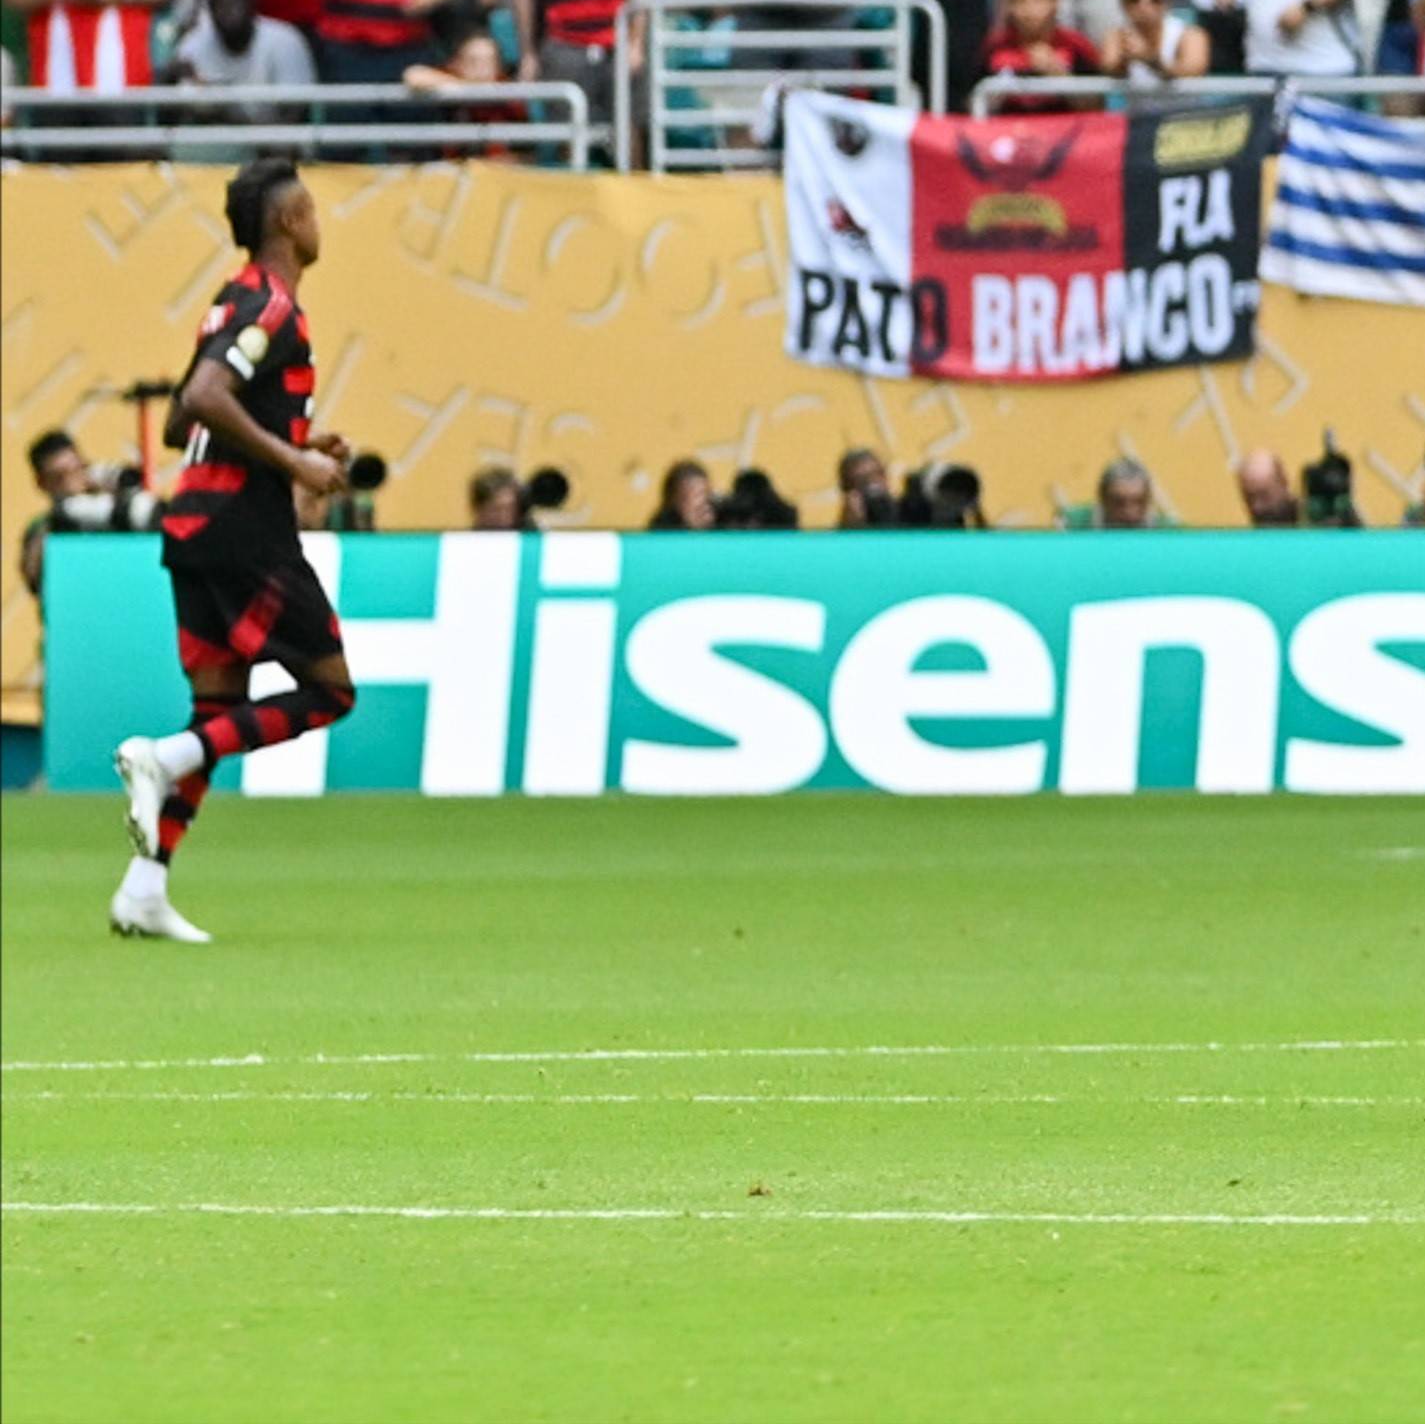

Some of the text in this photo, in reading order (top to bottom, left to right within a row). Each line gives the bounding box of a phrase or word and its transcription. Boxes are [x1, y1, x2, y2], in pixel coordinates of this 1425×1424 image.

[1157, 166, 1236, 255] FLA
[799, 253, 1237, 374] PATO BRANCO
